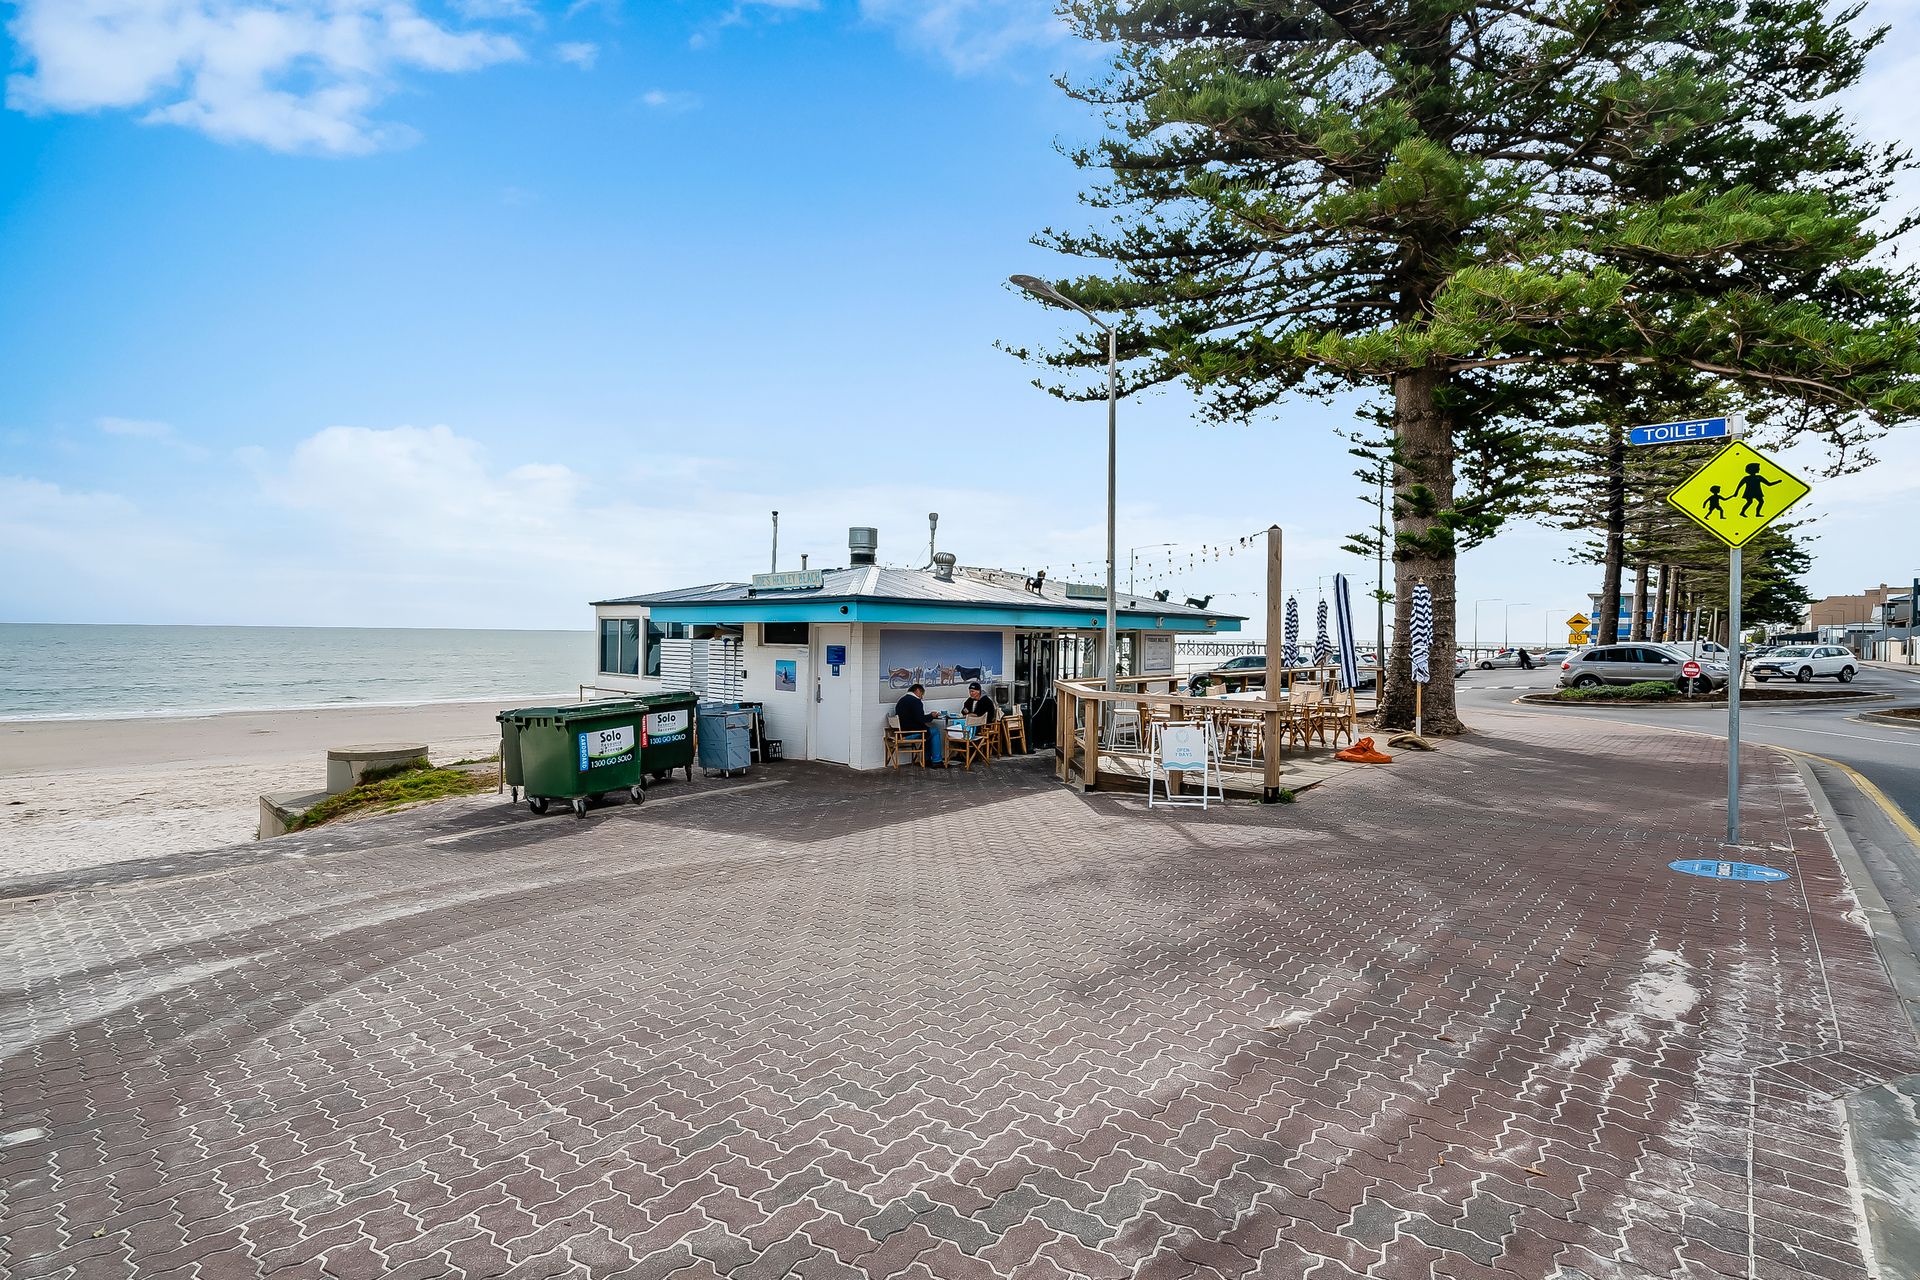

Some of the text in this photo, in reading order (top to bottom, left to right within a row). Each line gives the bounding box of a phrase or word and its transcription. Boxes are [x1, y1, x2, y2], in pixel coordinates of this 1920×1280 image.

[1643, 422, 1709, 441] TOILET
[799, 570, 820, 584] BEACH
[657, 712, 676, 724] Solo
[600, 730, 622, 743] Solo
[650, 733, 686, 745] 1300 GO SOLO
[591, 753, 632, 768] 1300 GO SOLO
